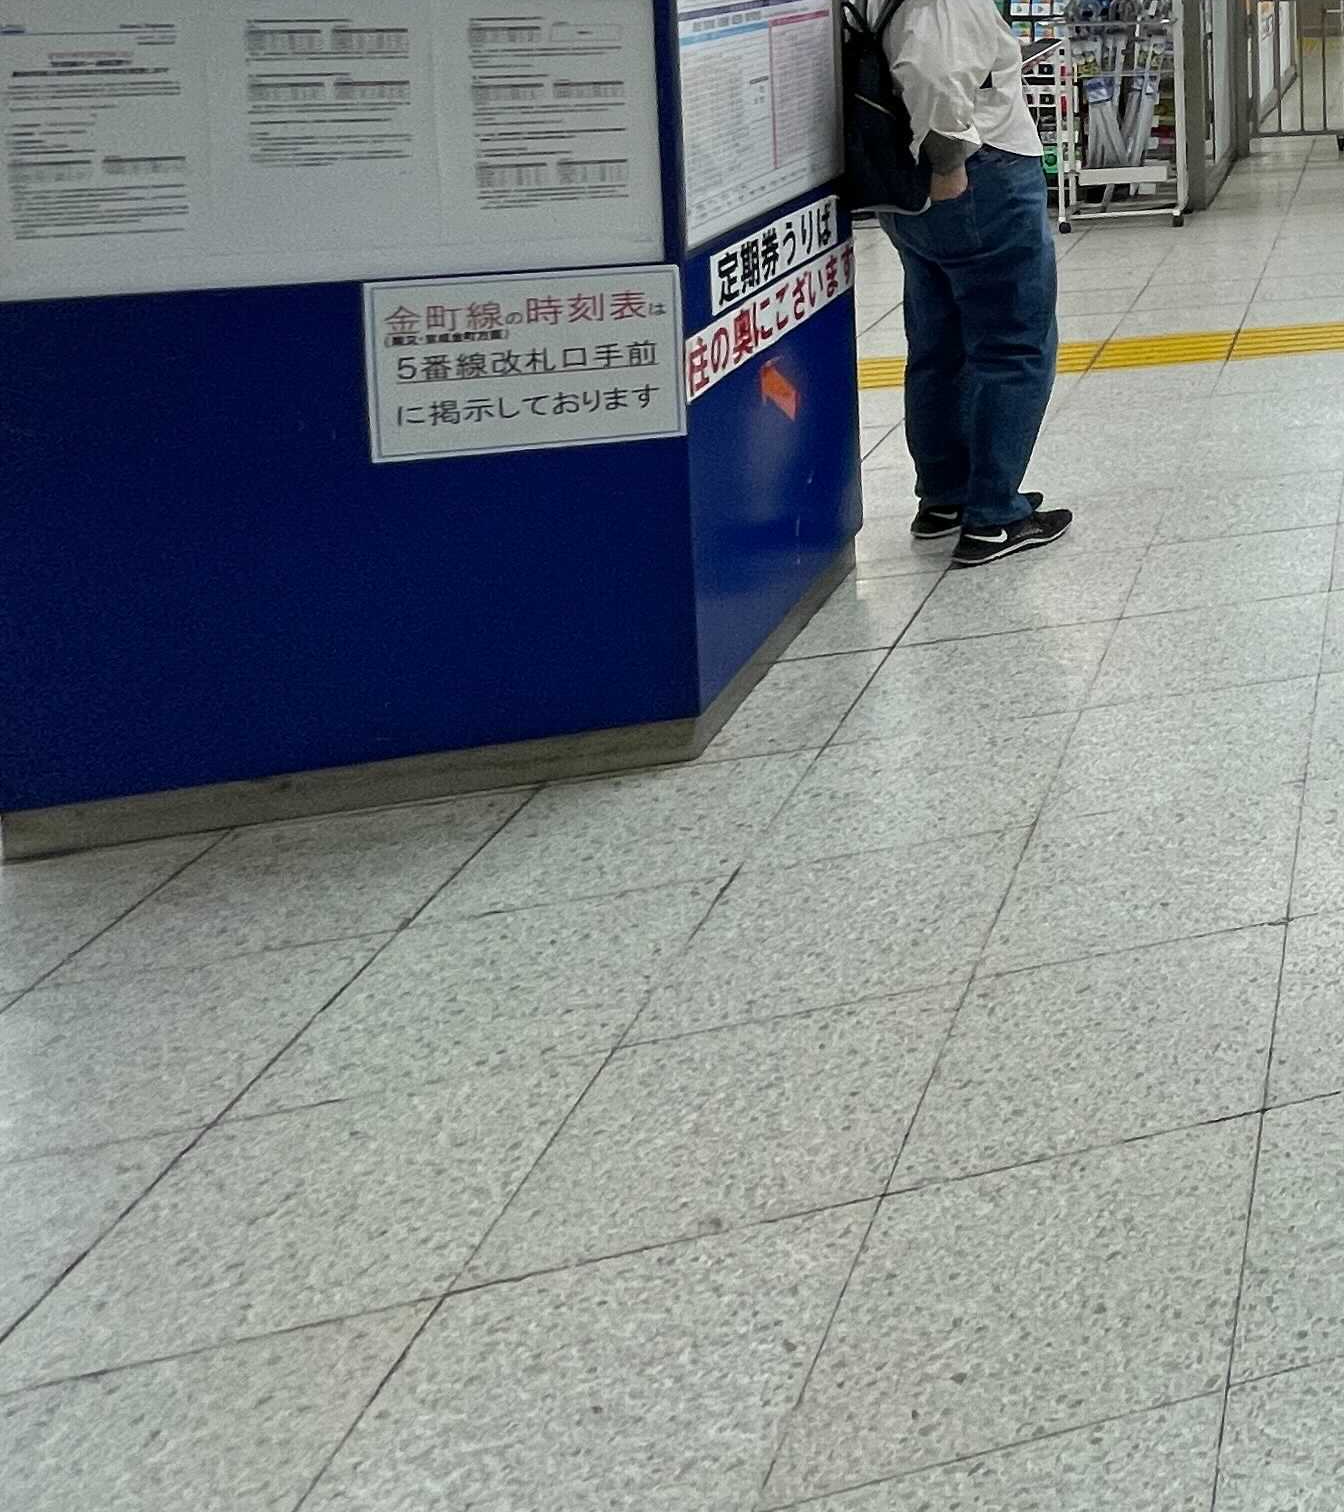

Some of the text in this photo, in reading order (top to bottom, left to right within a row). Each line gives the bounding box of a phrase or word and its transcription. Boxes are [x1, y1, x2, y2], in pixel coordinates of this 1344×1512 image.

[717, 199, 832, 306] 定期券うりば
[384, 289, 668, 335] 金町線の時刻表は
[398, 341, 658, 381] 5番線改札口手前
[397, 383, 661, 428] に掲示しております
